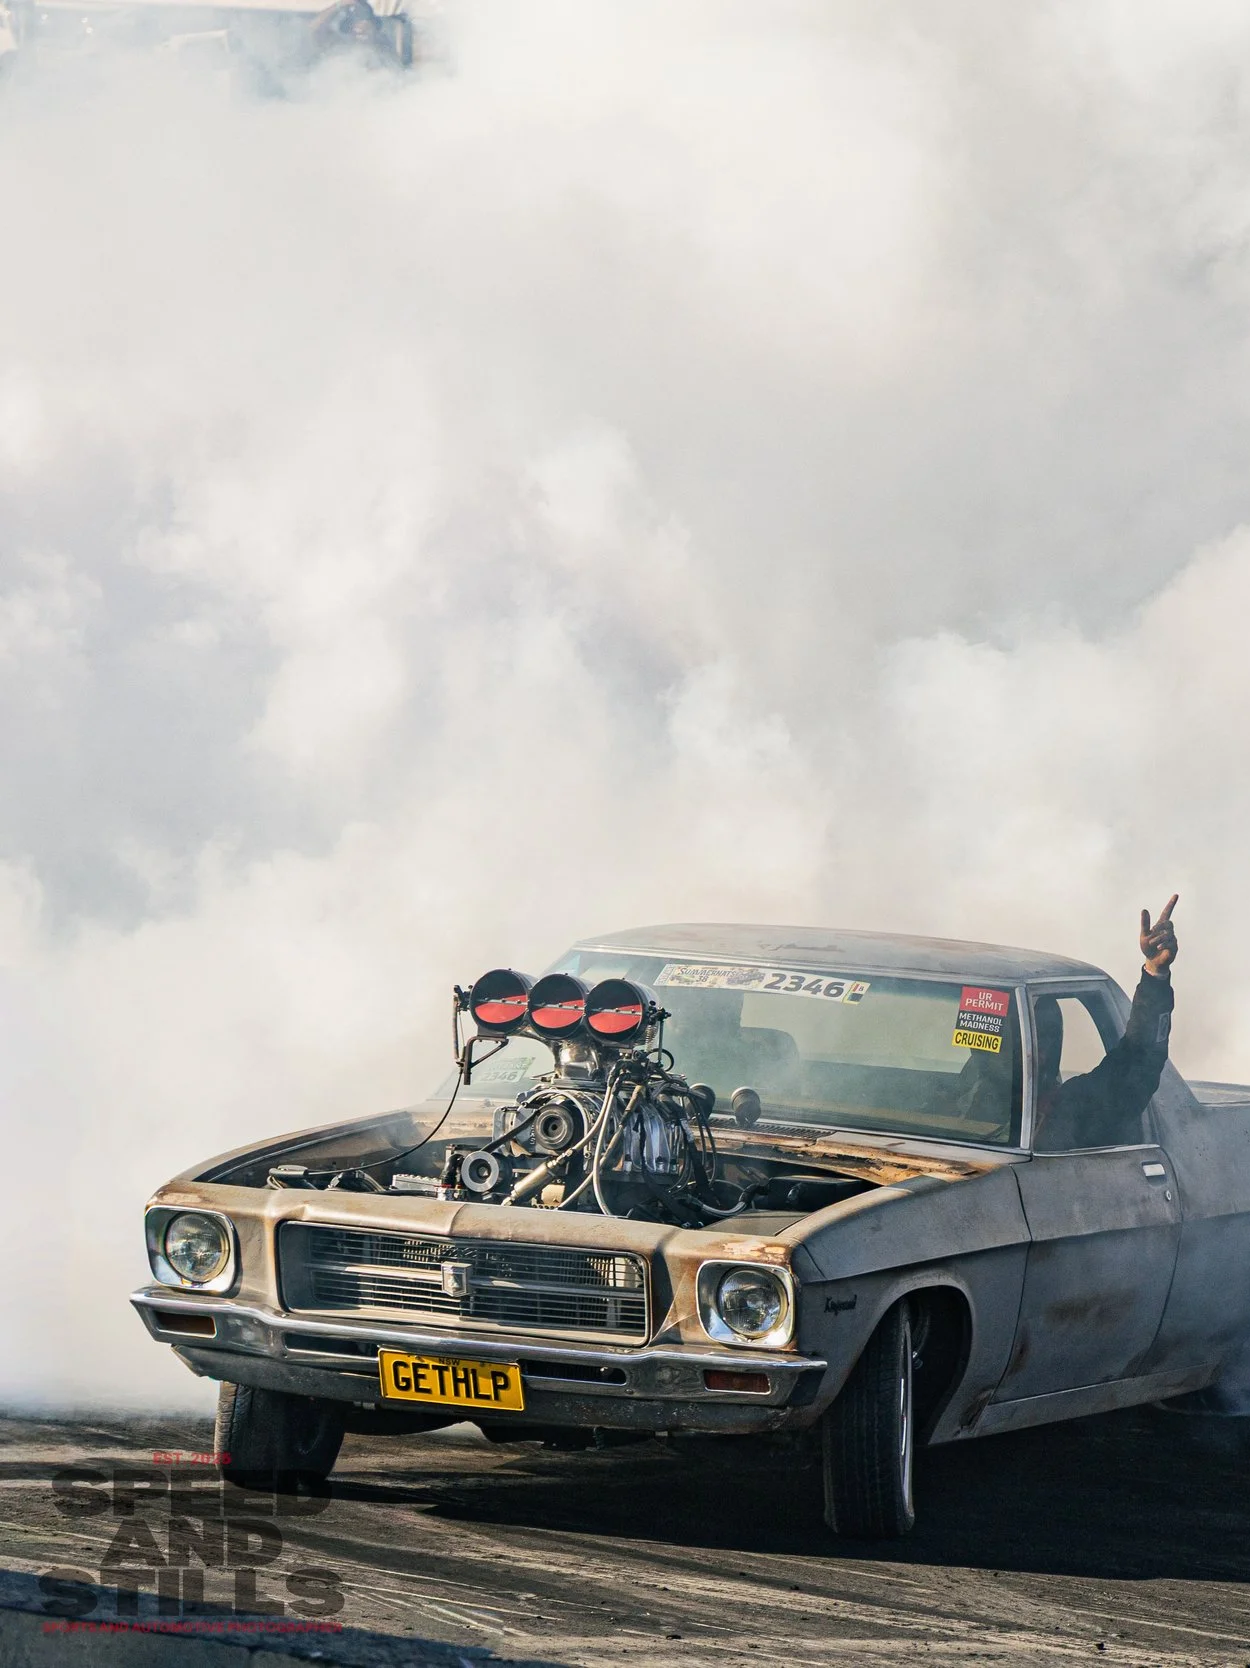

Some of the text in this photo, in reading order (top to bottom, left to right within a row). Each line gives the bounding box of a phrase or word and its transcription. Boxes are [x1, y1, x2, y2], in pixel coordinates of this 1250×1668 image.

[763, 973, 846, 998] 2346
[978, 991, 993, 1001] UR
[965, 998, 1004, 1011] PERMIT
[959, 1012, 1003, 1026] METHANOL
[960, 1020, 1000, 1033] MADNESS
[955, 1032, 999, 1050] CRUISING
[479, 1071, 518, 1081] 2346
[438, 1357, 460, 1366] NSW
[392, 1360, 509, 1401] GETHLP
